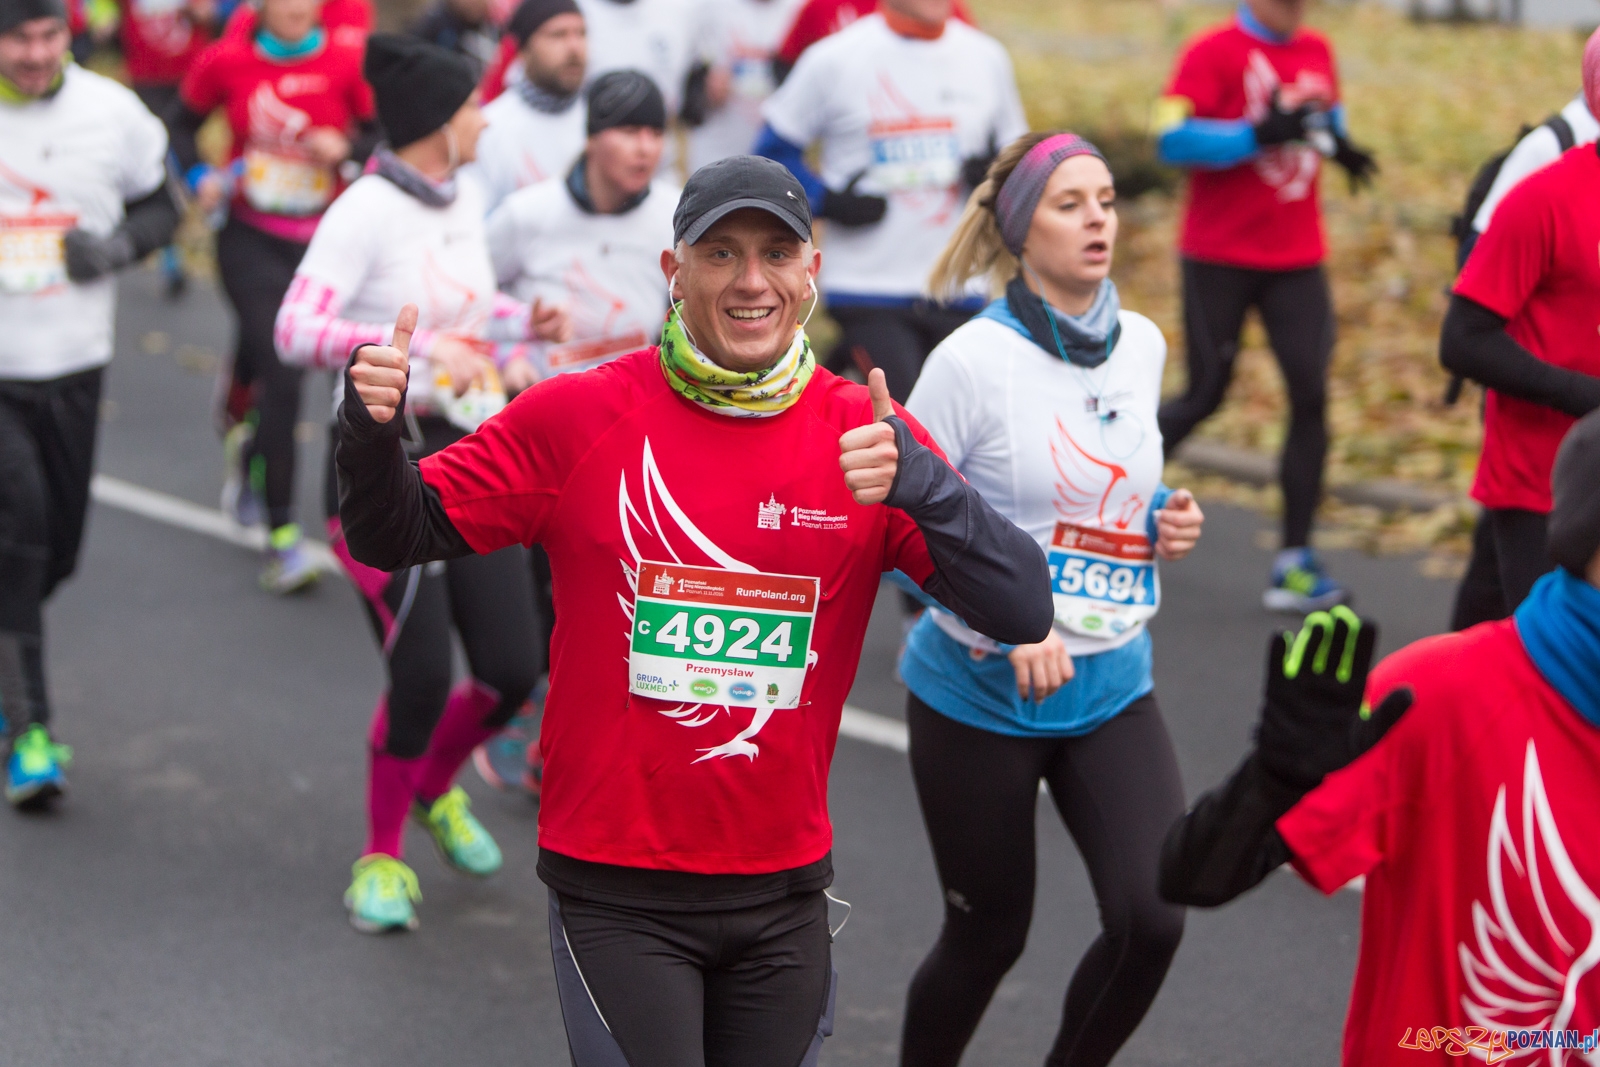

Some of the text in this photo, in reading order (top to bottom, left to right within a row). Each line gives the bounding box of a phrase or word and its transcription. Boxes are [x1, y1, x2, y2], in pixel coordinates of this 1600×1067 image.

[790, 506, 800, 527] 1
[1059, 557, 1147, 603] 5694
[736, 587, 806, 603] RunPoland.org
[655, 611, 793, 662] 4924
[686, 663, 754, 678] Przemysław
[636, 673, 663, 685] GRUPA
[636, 682, 668, 693] LUXMED
